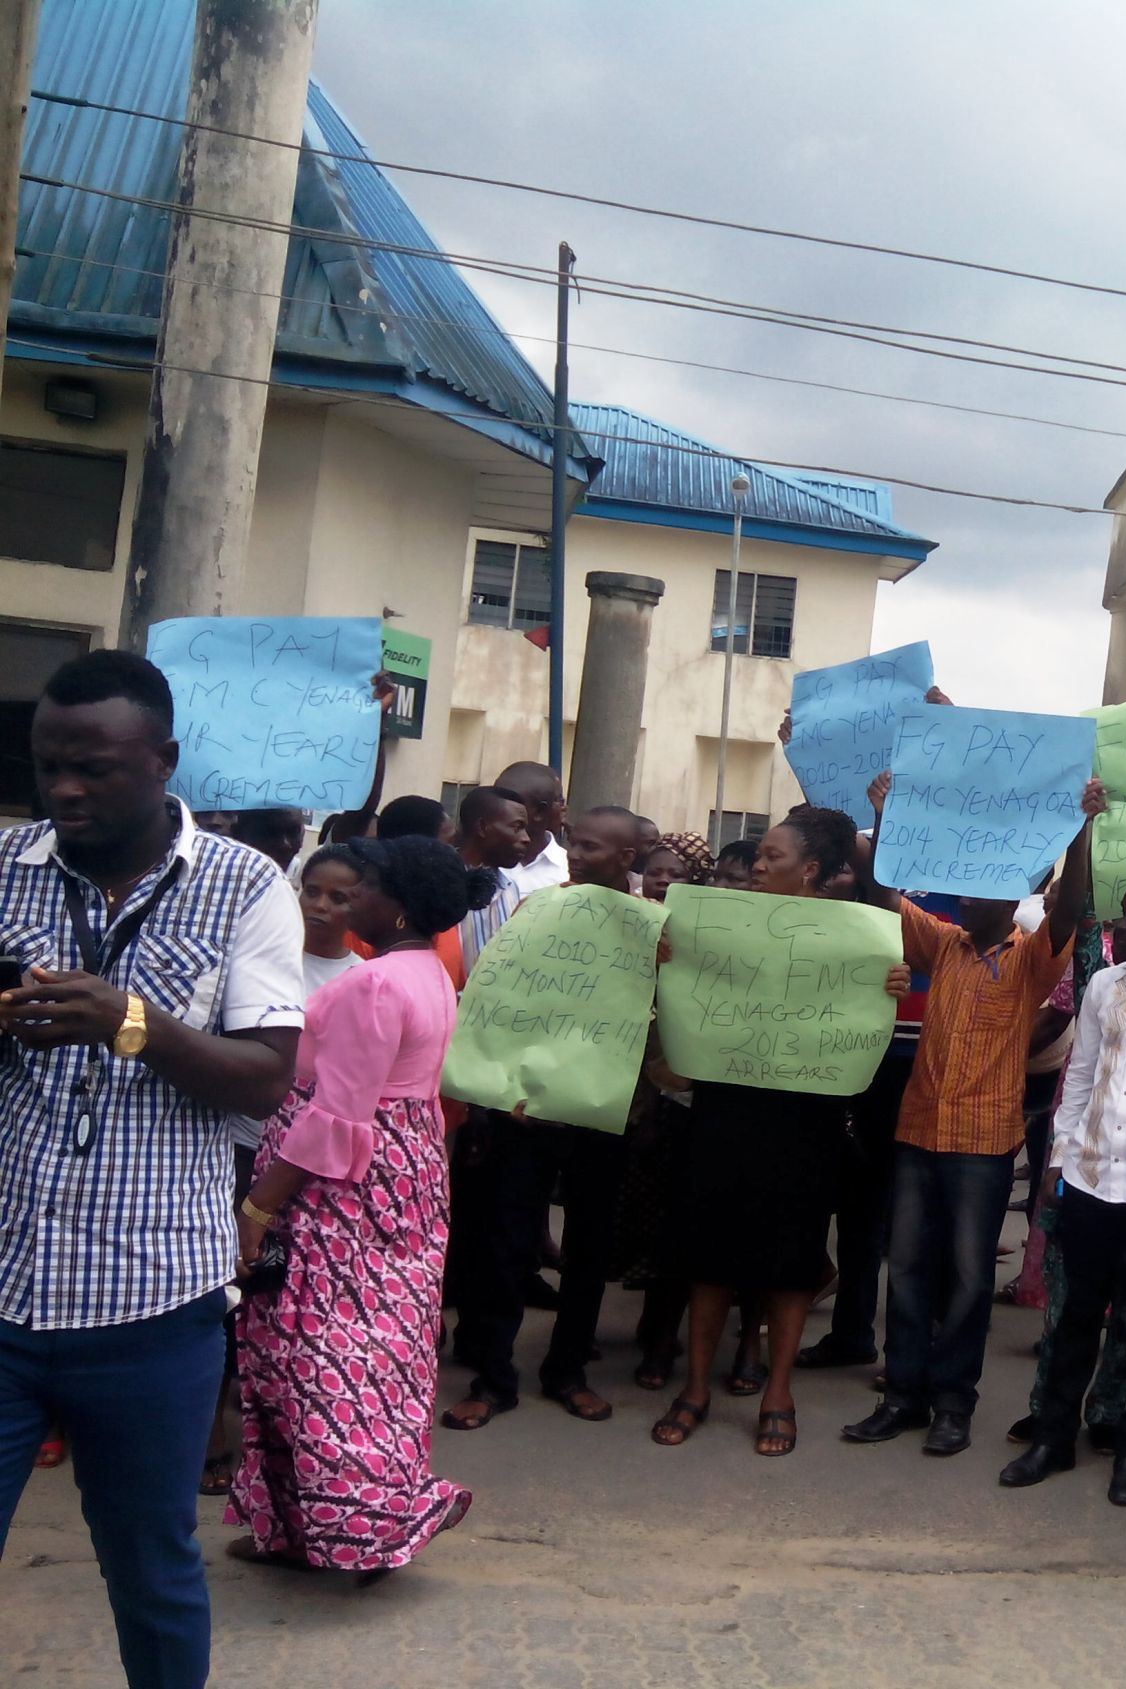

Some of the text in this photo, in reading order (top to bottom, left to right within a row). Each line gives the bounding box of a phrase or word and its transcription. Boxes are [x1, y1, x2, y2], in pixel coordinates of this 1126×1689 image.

[249, 623, 340, 673] PAY
[383, 648, 423, 667] FIDELITY
[854, 655, 903, 697] PAY
[179, 721, 377, 773] UR YEARLY
[895, 716, 1045, 775] FG PAY
[889, 772, 946, 810] FMC
[955, 785, 1078, 823] YENAGOA
[879, 820, 1065, 864] 2014 YEARLY
[892, 856, 1032, 883] INCREMEN
[558, 892, 617, 931] PAY
[620, 908, 661, 949] FMC
[541, 934, 656, 980] 2010-2013
[690, 950, 881, 1001] PAY FMC
[510, 967, 601, 1002] MONTH
[690, 991, 845, 1032] YENAGOA
[718, 1026, 801, 1061] 2013
[725, 1057, 844, 1081] ARREARS
